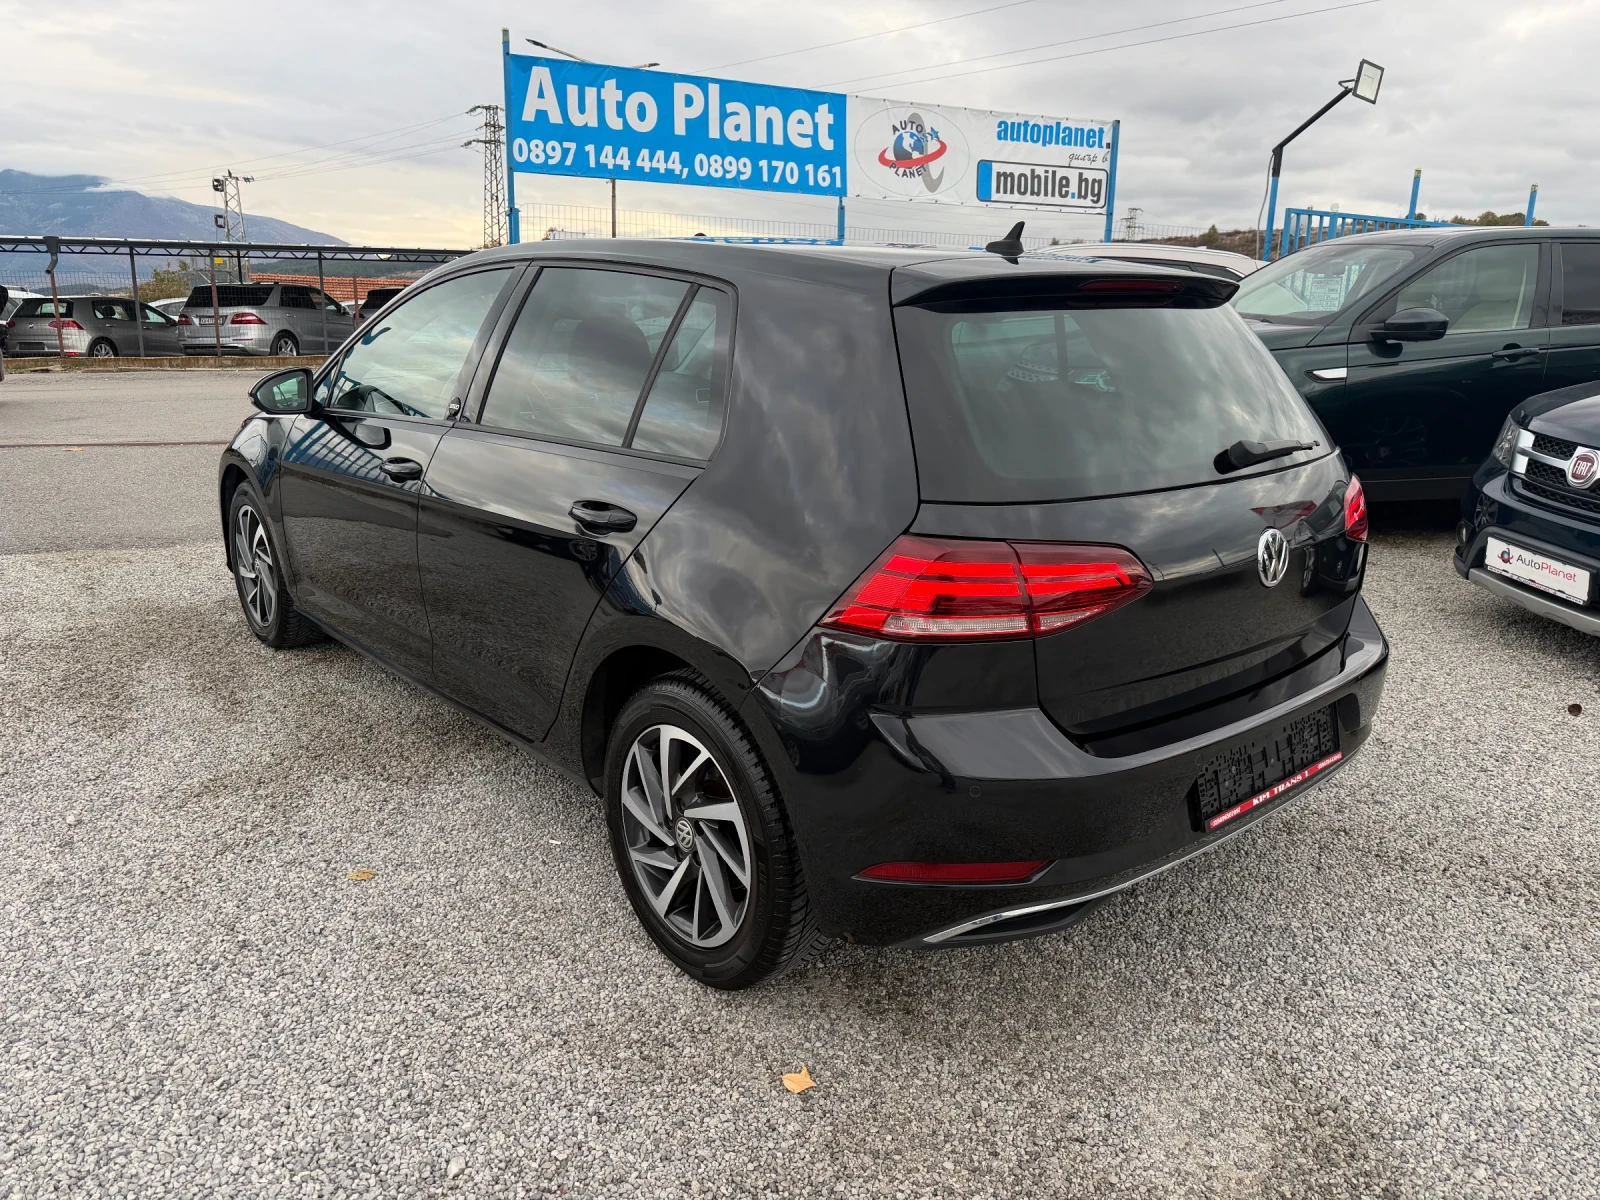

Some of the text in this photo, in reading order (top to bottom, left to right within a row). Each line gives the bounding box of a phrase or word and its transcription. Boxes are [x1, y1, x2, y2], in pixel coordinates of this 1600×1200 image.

[521, 65, 834, 151] Auto Planet
[892, 120, 924, 135] AUTO
[513, 137, 842, 188] 0897 144 444, 0899 170 161
[889, 162, 927, 179] PLANET
[995, 168, 1103, 204] mobile.bg
[1572, 460, 1592, 476] FIAT
[1516, 554, 1577, 582] AutoPlanet
[1252, 791, 1270, 806] KIM
[1273, 774, 1303, 795] TRANS
